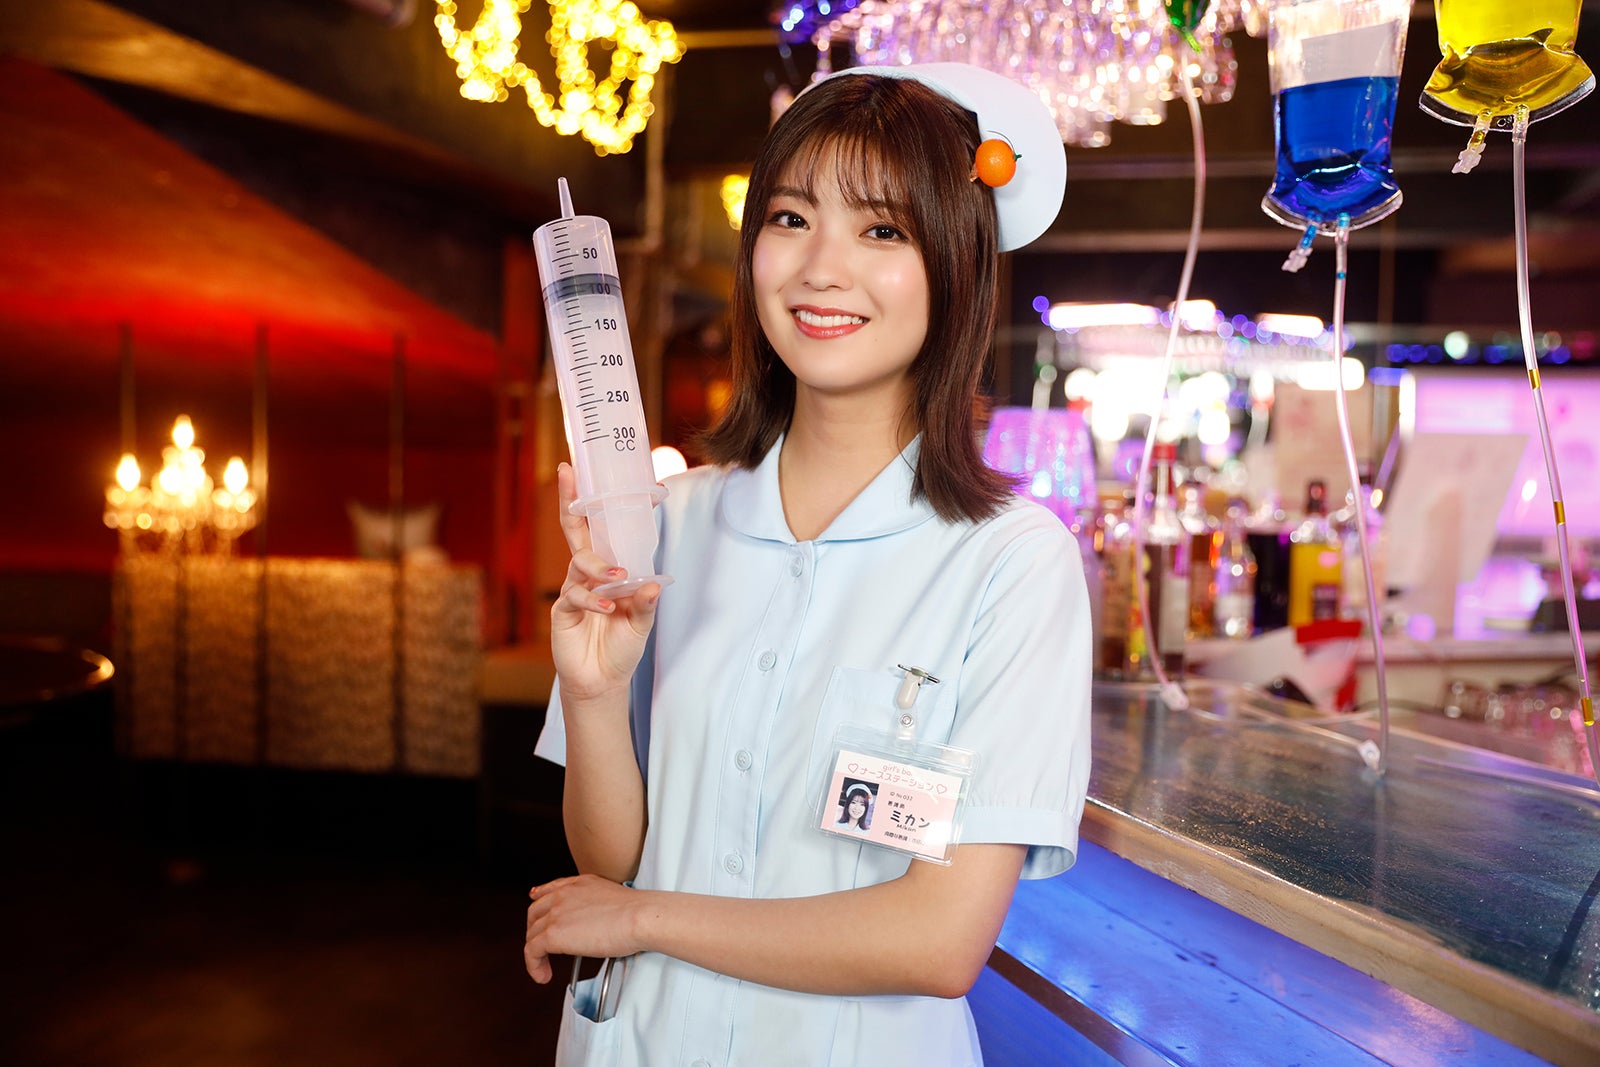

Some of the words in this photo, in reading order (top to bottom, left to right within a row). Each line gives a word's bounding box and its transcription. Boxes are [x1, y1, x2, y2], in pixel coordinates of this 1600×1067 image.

[582, 247, 598, 260] 50
[594, 318, 617, 331] 150
[600, 354, 623, 367] 200
[606, 390, 629, 403] 250
[613, 427, 636, 439] 300
[615, 440, 636, 452] CC
[859, 767, 934, 791] ナースステーション
[890, 810, 931, 828] ミカン
